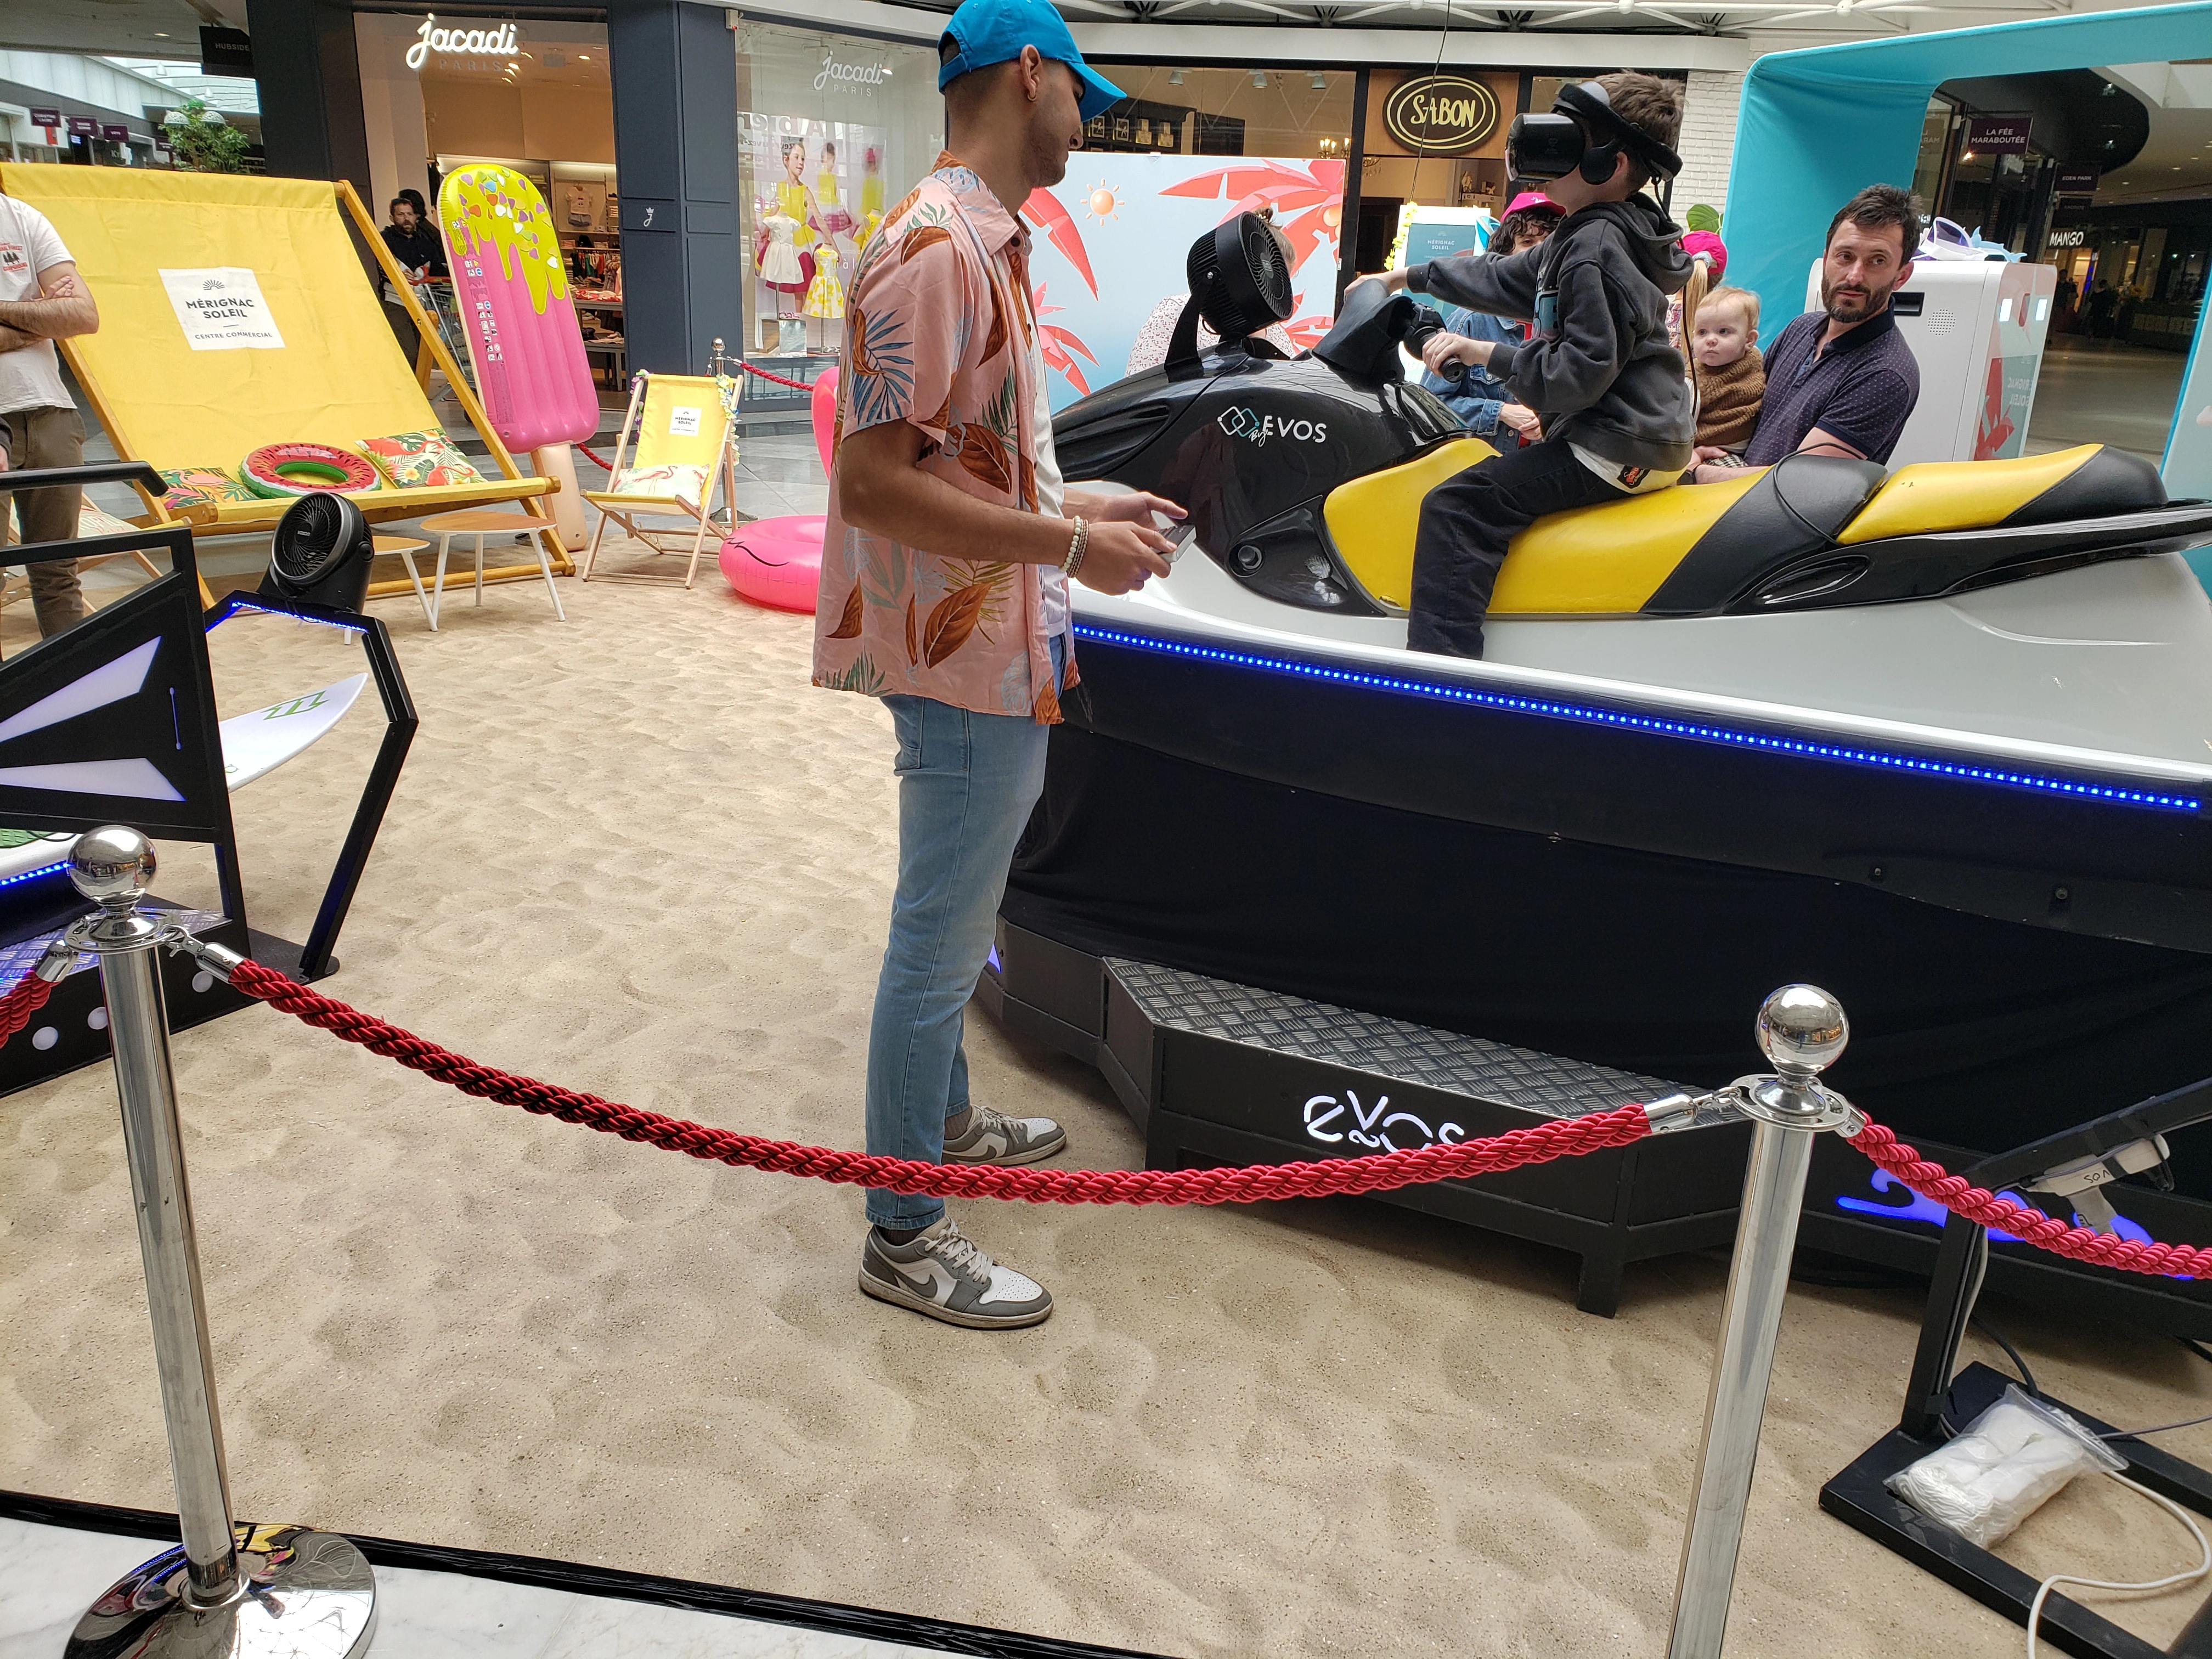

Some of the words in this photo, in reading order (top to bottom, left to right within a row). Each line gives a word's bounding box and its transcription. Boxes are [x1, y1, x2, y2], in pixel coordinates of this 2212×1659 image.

[215, 43, 250, 51] HUBSIDE
[406, 13, 519, 69] jacadi
[439, 59, 503, 72] PARIS
[814, 50, 883, 91] jacadi
[834, 84, 872, 97] PARIS
[1410, 94, 1476, 128] SABON
[1998, 127, 2014, 136] FÉE
[2049, 231, 2084, 246] MANGO
[185, 298, 255, 309] MÉRIGNAC
[203, 308, 248, 319] SOLEIL
[1248, 428, 1268, 447] By
[1262, 415, 1327, 443] EVOS
